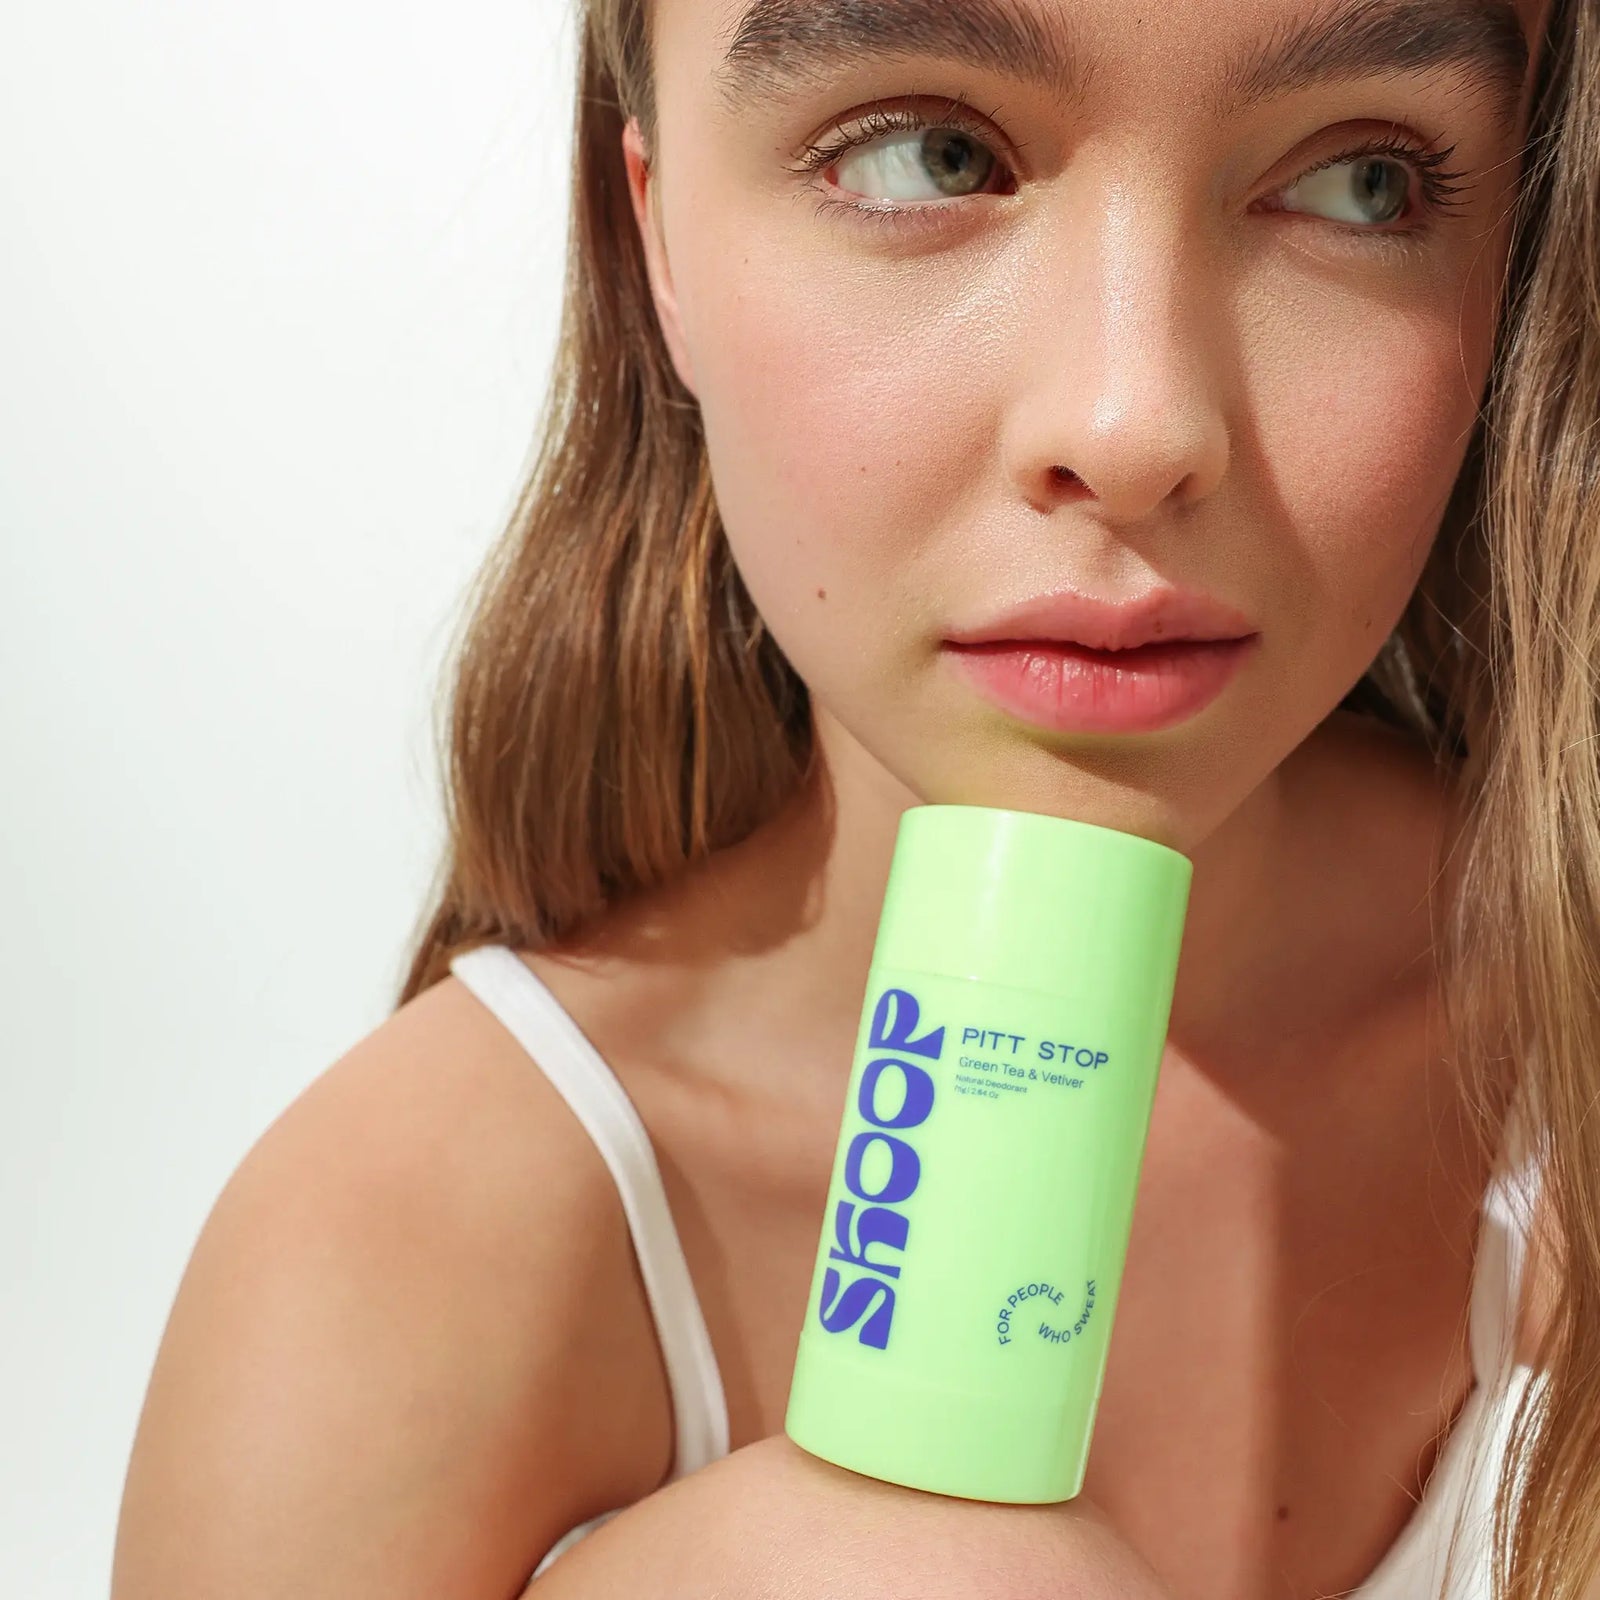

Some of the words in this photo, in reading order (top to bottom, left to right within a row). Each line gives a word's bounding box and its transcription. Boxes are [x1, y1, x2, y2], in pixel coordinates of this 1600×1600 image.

[962, 1027, 1026, 1054] PITT
[1038, 1041, 1110, 1070] STOP
[956, 1074, 984, 1086] Natural
[985, 1079, 1028, 1093] Deodorant
[959, 1056, 998, 1073] Green
[1001, 1063, 1025, 1078] Tea
[1028, 1068, 1038, 1081] &
[1041, 1070, 1084, 1089] Vetiver
[997, 1308, 1013, 1345] FOR
[1007, 1283, 1065, 1308] PEOPLE
[1038, 1322, 1071, 1344] WHO
[1074, 1279, 1096, 1336] SWEAT
